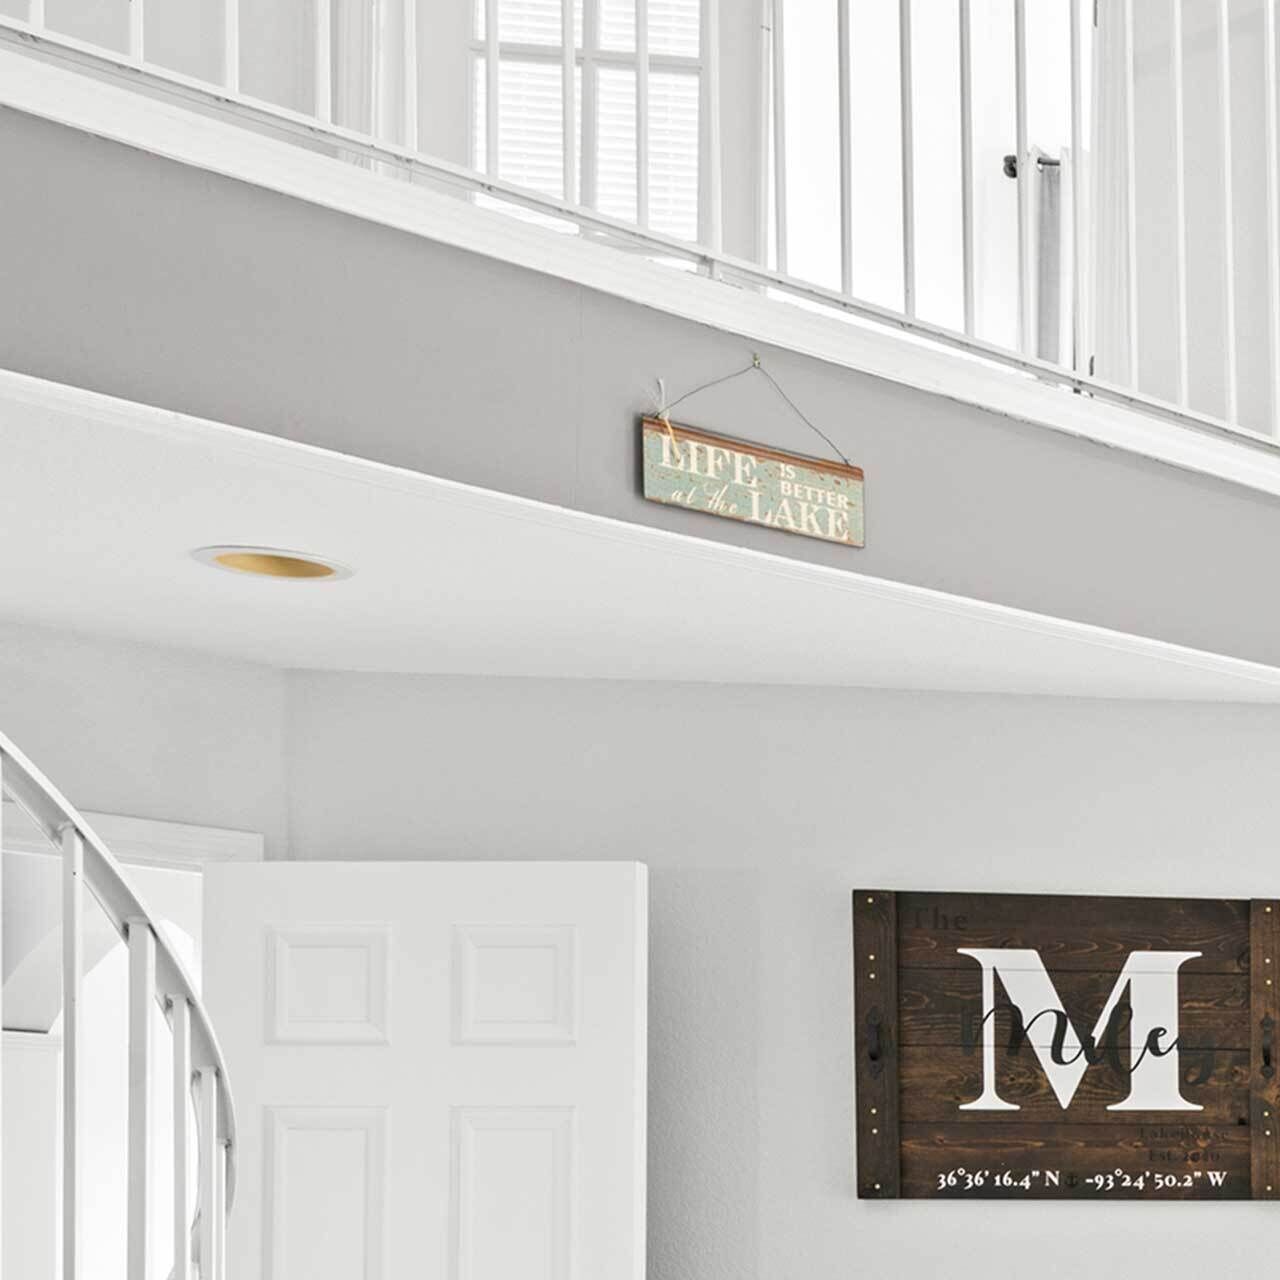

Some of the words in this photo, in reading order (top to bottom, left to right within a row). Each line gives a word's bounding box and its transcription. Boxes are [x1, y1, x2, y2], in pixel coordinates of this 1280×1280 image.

[660, 433, 758, 488] LIFE
[780, 463, 796, 480] IS
[671, 487, 696, 505] at
[707, 484, 738, 514] the
[750, 490, 849, 541] LAKE
[780, 480, 849, 511] BETTER
[957, 948, 1203, 1111] M
[1044, 1169, 1060, 1187] N
[1206, 1170, 1228, 1187] W
